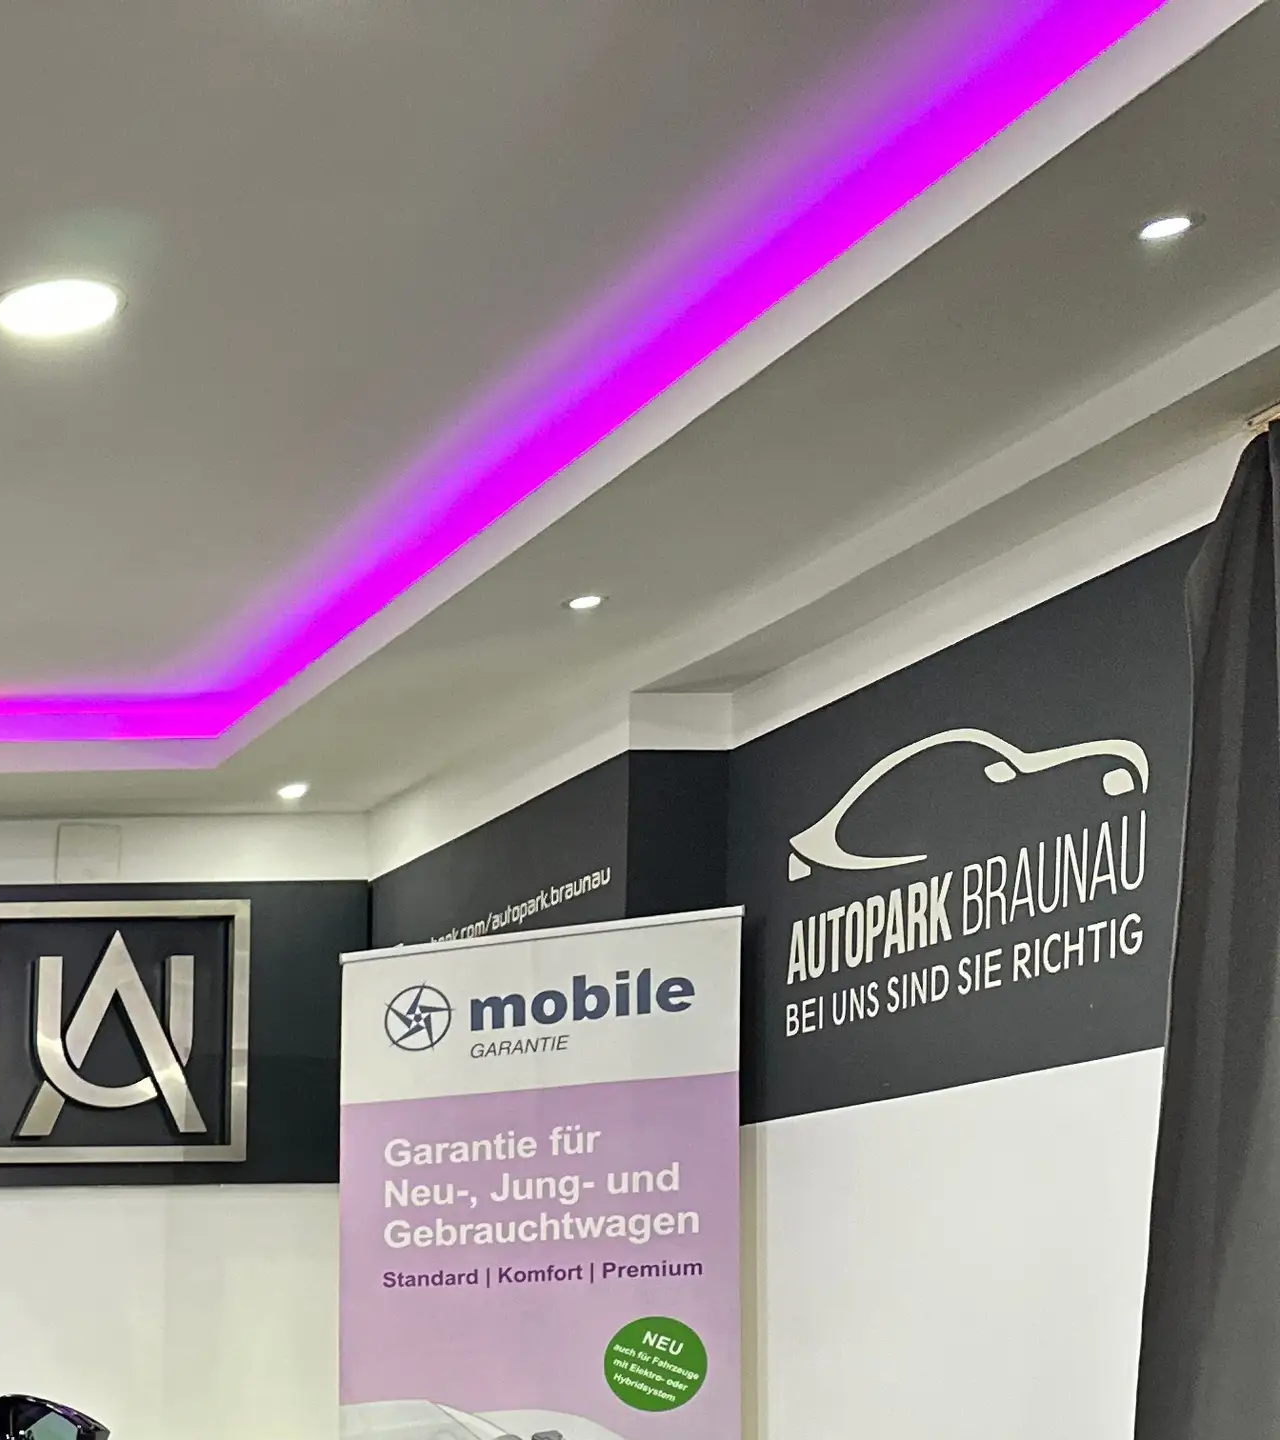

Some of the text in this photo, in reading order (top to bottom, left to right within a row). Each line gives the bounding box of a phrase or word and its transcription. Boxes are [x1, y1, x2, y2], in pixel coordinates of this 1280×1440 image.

[787, 809, 1147, 984] AUTOPARK BRAUNAU
[786, 912, 1144, 1037] BEI UNS SIND SIE RICHTIG
[470, 967, 695, 1031] mobile
[470, 1034, 570, 1059] GARANTIE
[384, 1125, 601, 1167] Garantie für
[384, 1162, 680, 1208] Neu-, Jung- und
[383, 1211, 700, 1249] Gebrauchtwagen
[382, 1269, 479, 1288] Standard
[498, 1264, 583, 1284] Komfort
[602, 1260, 703, 1279] Premium
[642, 1331, 684, 1355] NEU
[613, 1344, 699, 1380] auch für Fahrzeuge
[613, 1358, 629, 1369] mit
[666, 1378, 689, 1391] oder
[613, 1373, 676, 1402] Hybridsystem
